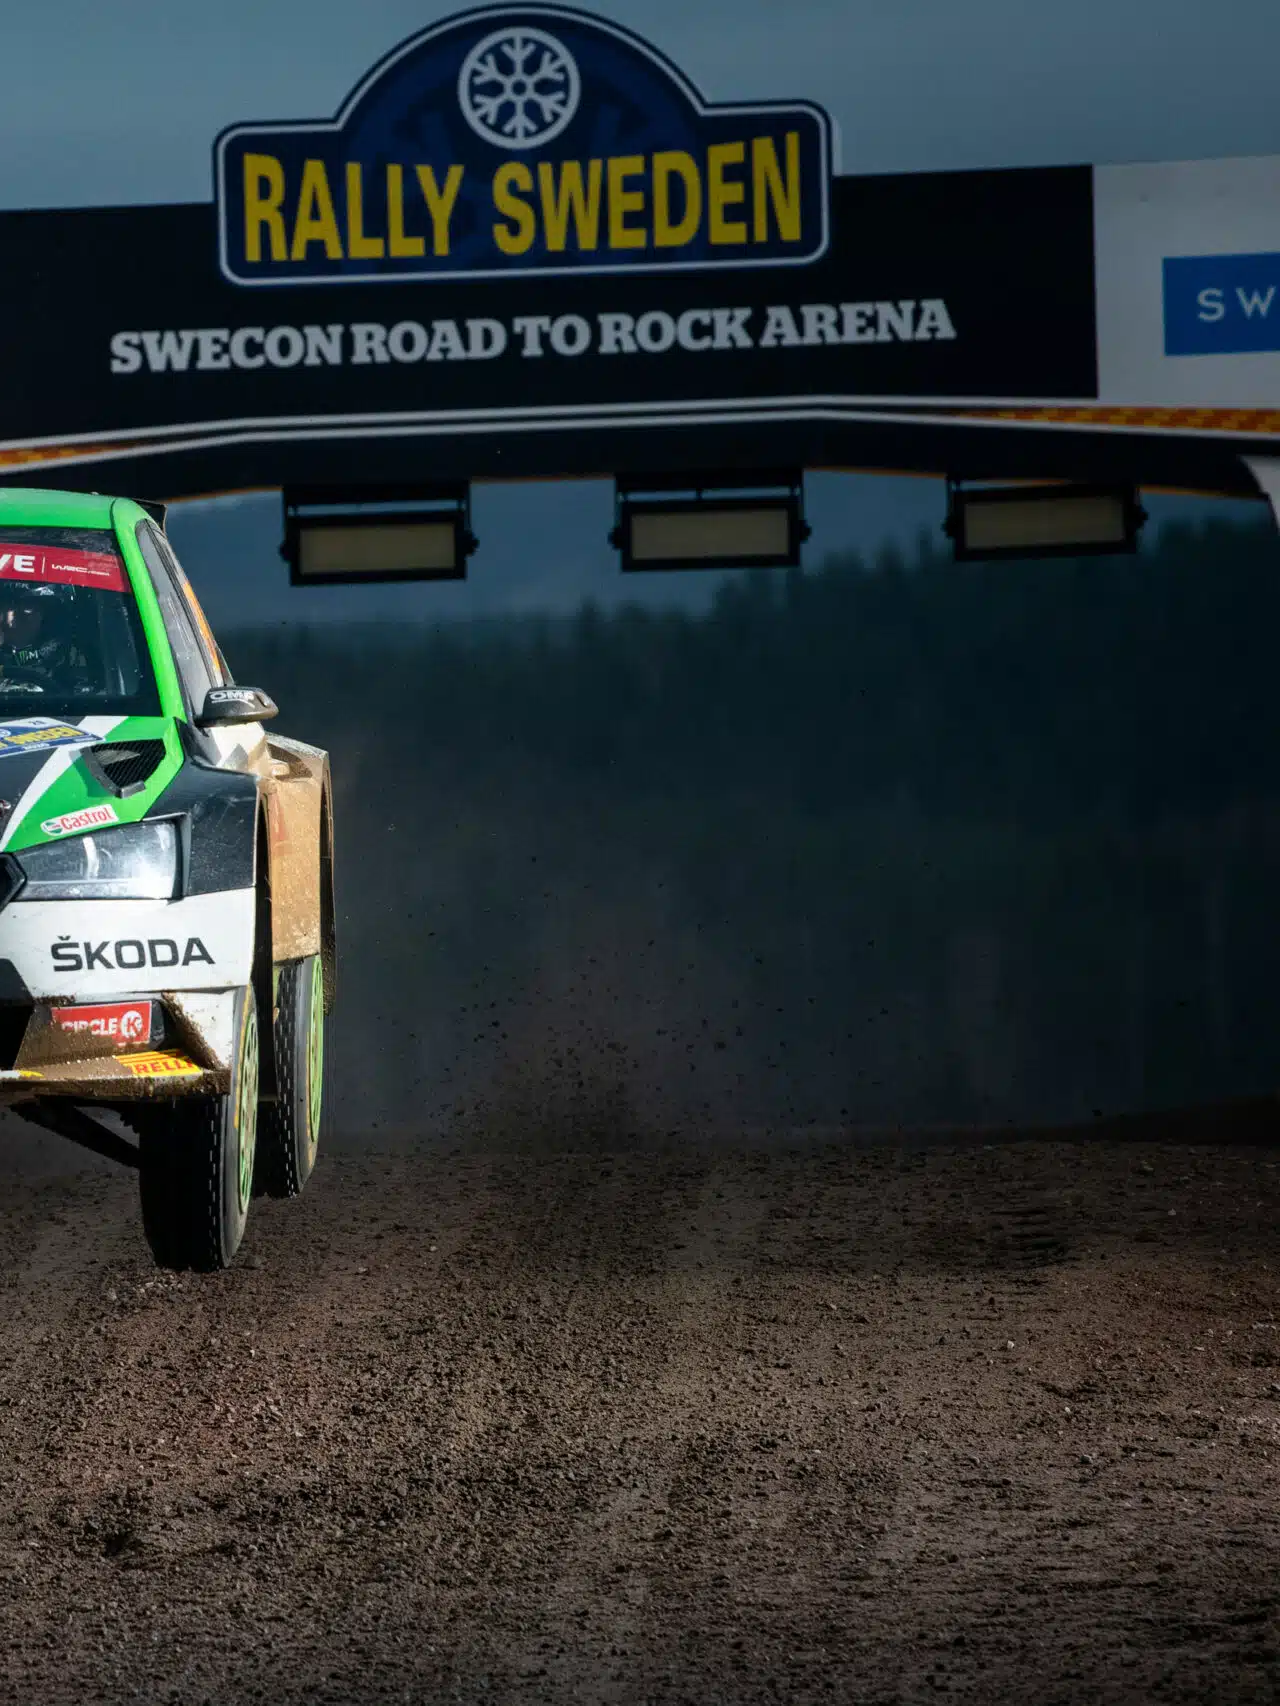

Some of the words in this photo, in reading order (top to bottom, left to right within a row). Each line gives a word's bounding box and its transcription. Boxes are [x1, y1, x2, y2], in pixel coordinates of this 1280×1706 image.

[242, 152, 465, 263] RALLY
[491, 130, 803, 256] SWEDEN
[109, 324, 345, 374] SWECON
[350, 317, 508, 365] ROAD
[512, 314, 592, 358] TO
[597, 307, 754, 354] ROCK
[759, 298, 957, 347] ARENA
[4, 726, 85, 745] SWEDEN
[60, 807, 114, 830] Castrol
[50, 934, 217, 973] ŠKODA
